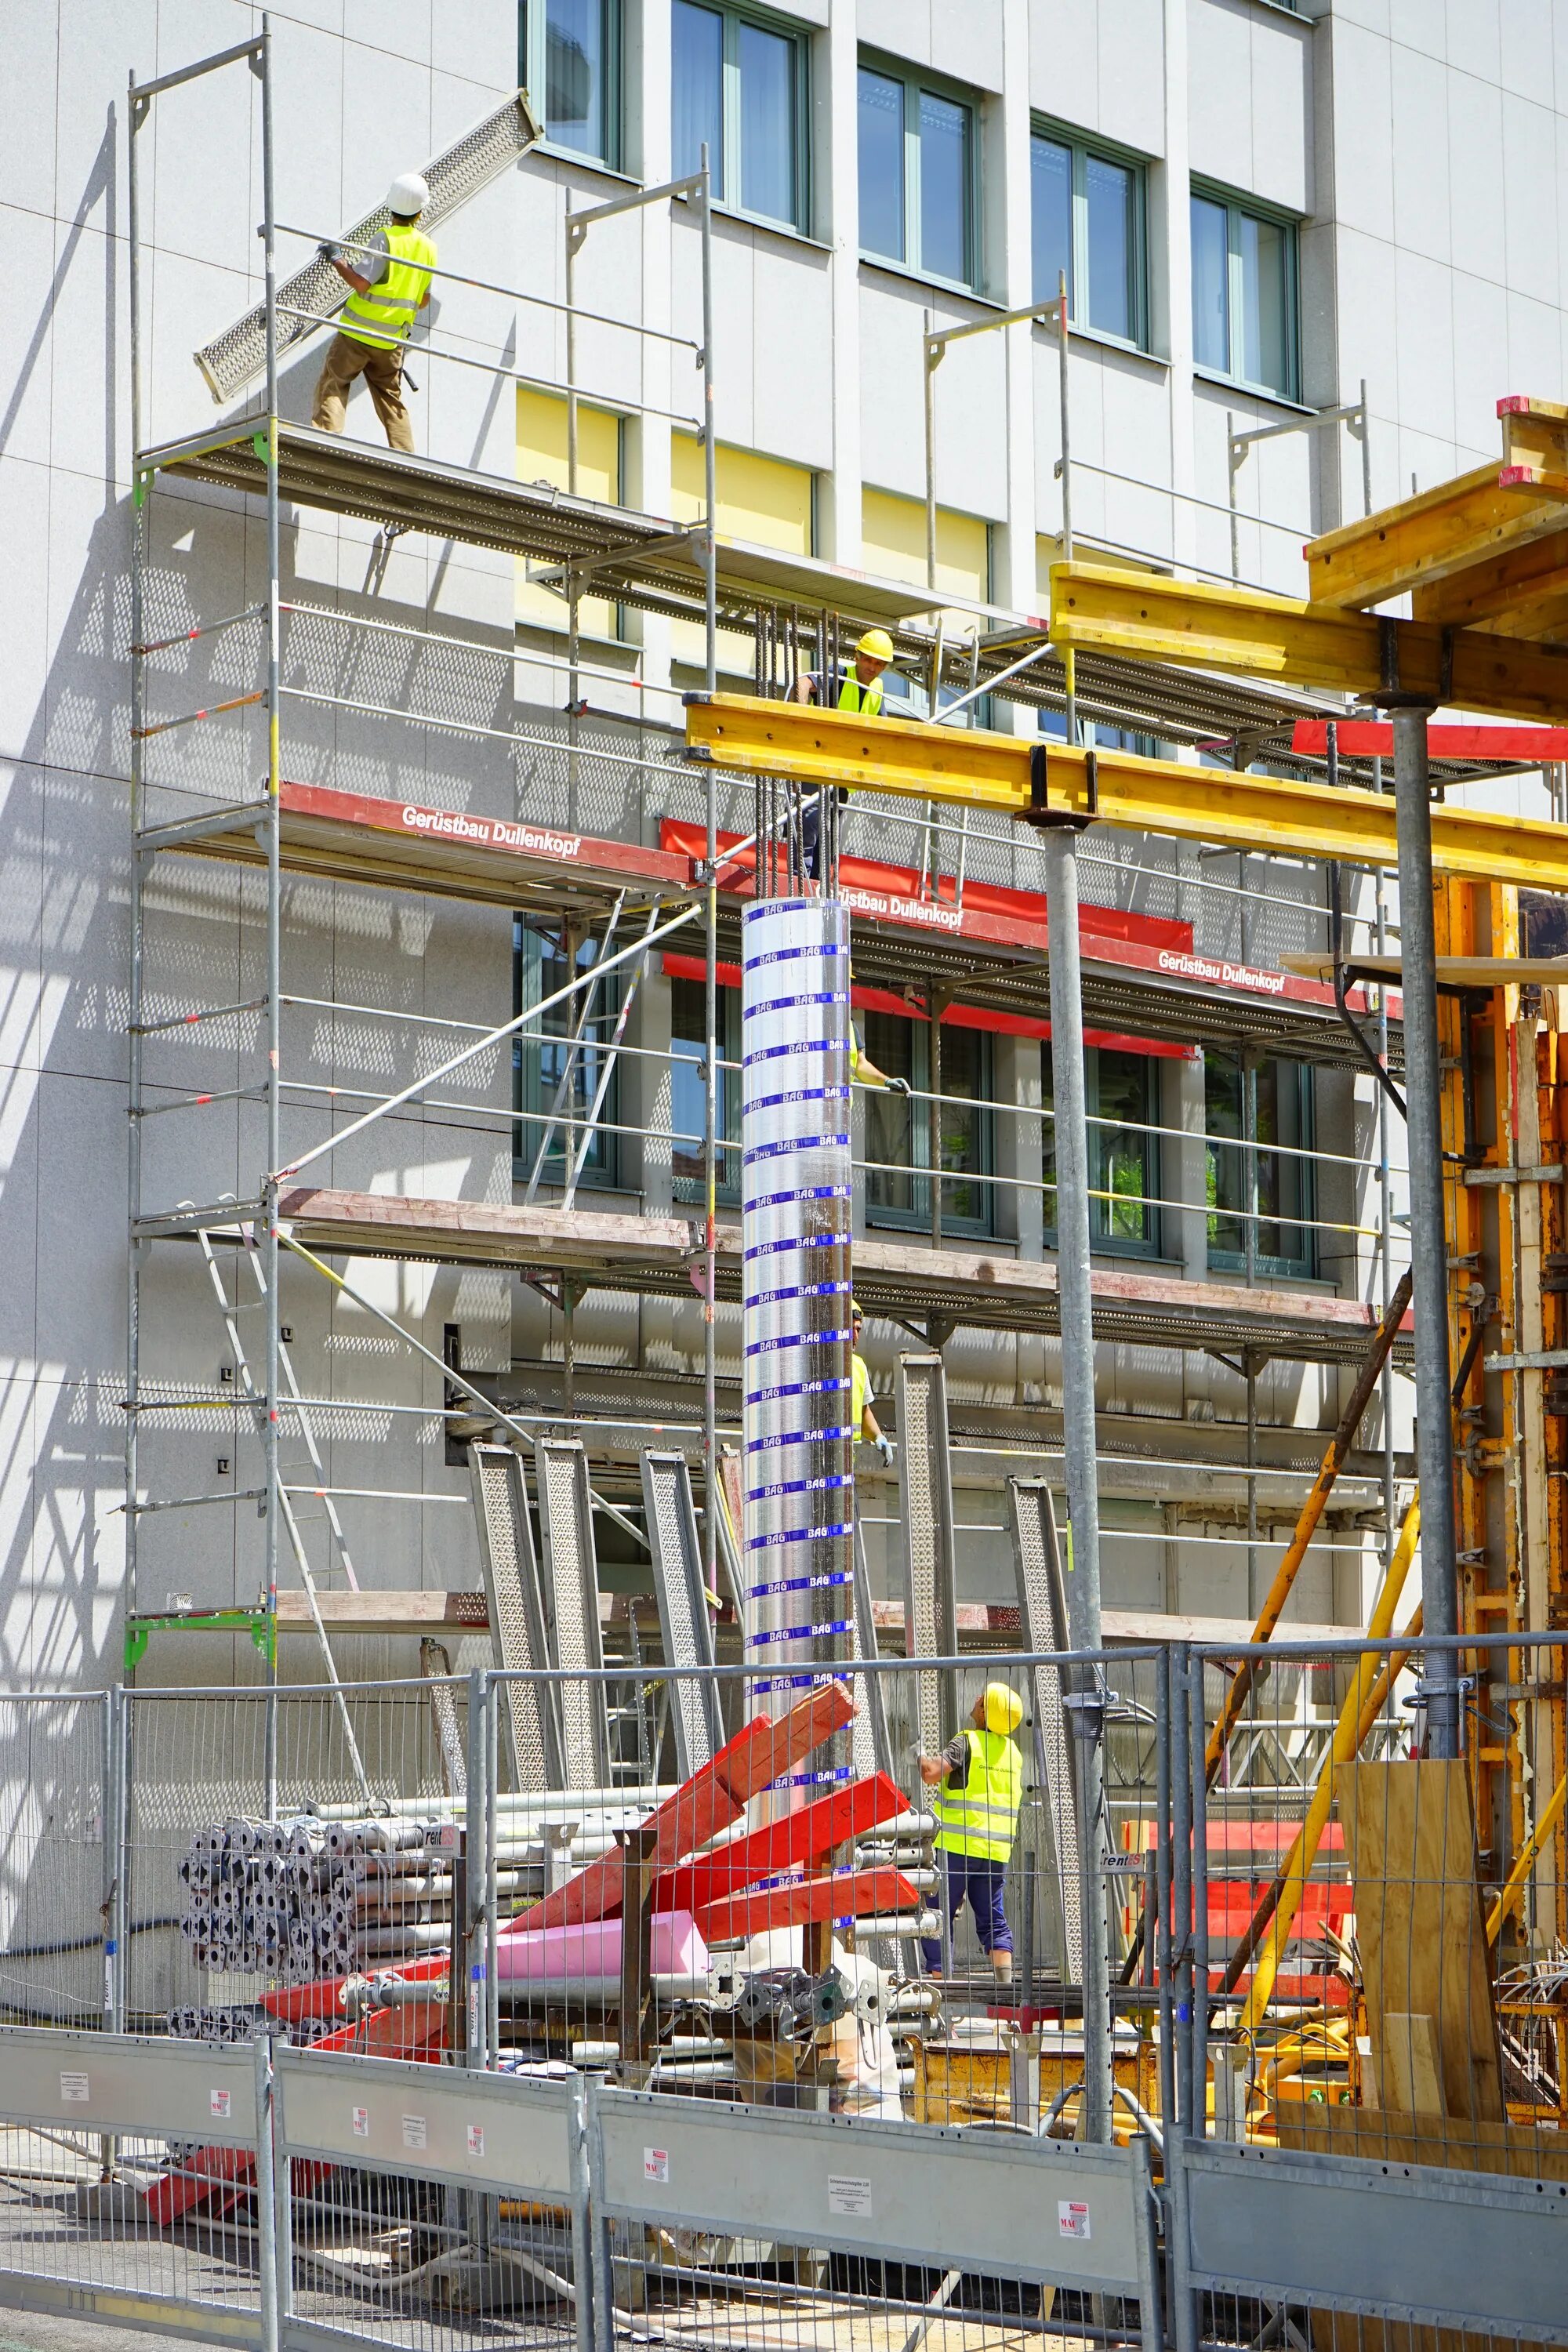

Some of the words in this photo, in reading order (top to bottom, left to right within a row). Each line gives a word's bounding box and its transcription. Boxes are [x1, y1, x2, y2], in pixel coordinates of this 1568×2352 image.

[402, 806, 489, 840] Gerüstbau
[492, 822, 582, 858] Dullenkopf
[764, 902, 782, 916] BAG
[890, 898, 964, 928] Dullenkopf
[759, 953, 778, 965] BAG
[800, 946, 821, 957] BAG
[1158, 951, 1220, 978] Gerüstbau
[1222, 964, 1286, 993] Dullenkopf
[755, 1002, 773, 1014] BAG
[793, 995, 815, 1006] BAG
[833, 993, 847, 1003] BAG
[751, 1050, 768, 1063] BAG
[788, 1042, 810, 1054] BAG
[829, 1040, 844, 1051] BAG
[748, 1099, 764, 1112] BAG
[782, 1091, 804, 1103] BAG
[824, 1087, 840, 1098] BAG
[777, 1139, 798, 1152] BAG
[819, 1135, 837, 1146] BAG
[755, 1196, 773, 1208] BAG
[793, 1188, 815, 1200] BAG
[833, 1185, 847, 1196] BAG
[757, 1243, 775, 1255] BAG
[795, 1236, 816, 1248] BAG
[834, 1232, 848, 1243] BAG
[758, 1291, 776, 1303] BAG
[797, 1284, 818, 1296] BAG
[836, 1281, 849, 1292] BAG
[760, 1339, 778, 1352] BAG
[800, 1332, 821, 1345] BAG
[837, 1329, 850, 1340] BAG
[761, 1387, 780, 1399] BAG
[801, 1381, 822, 1393] BAG
[763, 1436, 782, 1448] BAG
[804, 1428, 824, 1441] BAG
[764, 1485, 783, 1497] BAG
[805, 1477, 826, 1490] BAG
[766, 1533, 786, 1546] BAG
[807, 1526, 828, 1538] BAG
[768, 1581, 787, 1593] BAG
[809, 1574, 829, 1587] BAG
[769, 1630, 789, 1642] BAG
[811, 1622, 831, 1635] BAG
[771, 1678, 791, 1691] BAG
[425, 1826, 454, 1846] rentES
